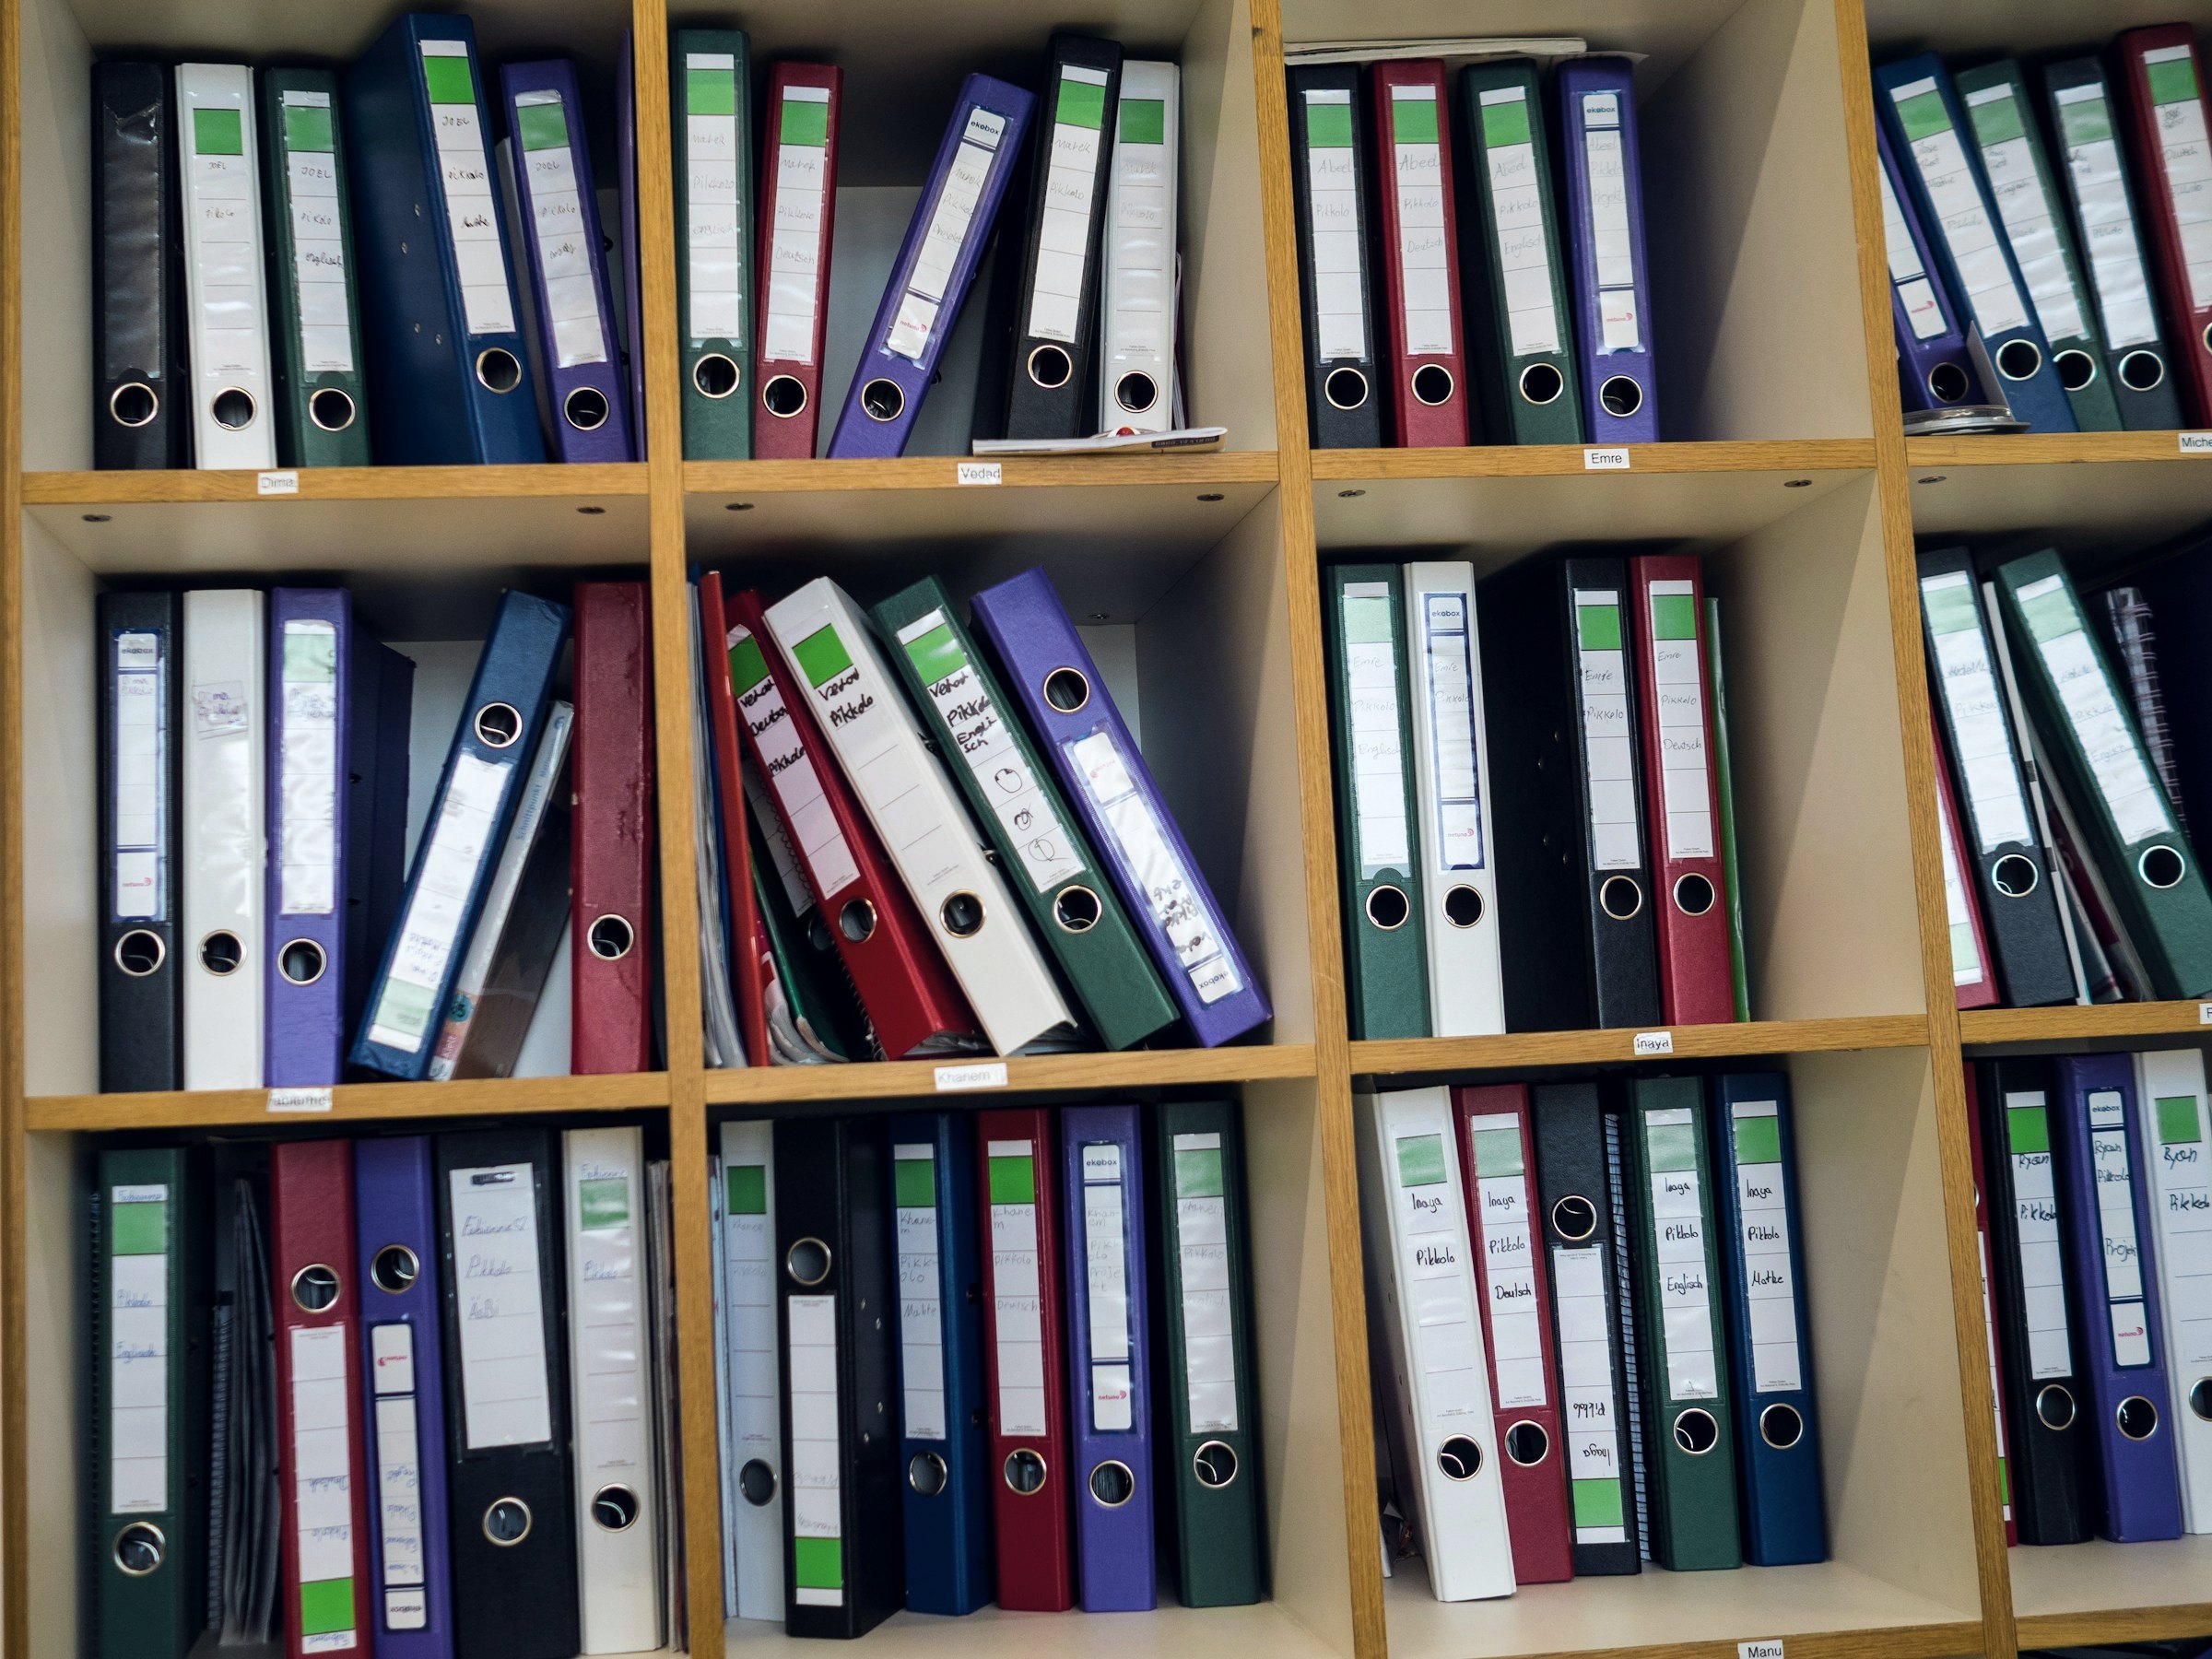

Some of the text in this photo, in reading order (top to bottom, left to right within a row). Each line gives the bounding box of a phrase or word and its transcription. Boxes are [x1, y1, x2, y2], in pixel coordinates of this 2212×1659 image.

[1586, 105, 1617, 114] ekobox
[970, 120, 1000, 136] ekobox
[1053, 137, 1092, 155] Marek
[1316, 203, 1350, 218] Pikkolo
[1592, 453, 1623, 465] Emre
[960, 467, 1001, 479] Vedad
[1431, 609, 1461, 618] ekobox
[1657, 650, 1682, 662] Emre
[1660, 694, 1697, 706] Pikkolo
[830, 693, 875, 727] Pikkolo
[1663, 737, 1702, 750] Deutsch
[1086, 1159, 1118, 1167] ekobox
[1746, 1179, 1773, 1199] Inaya
[1411, 1193, 1443, 1214] Inaya
[1488, 1191, 1516, 1210] Inaya
[1665, 1224, 1699, 1241] Pikkolo
[1747, 1225, 1781, 1241] Pikkolo
[1488, 1235, 1525, 1254] Pikkolo
[1416, 1246, 1456, 1266] Pikkolo
[1494, 1282, 1532, 1300] Deutsch
[1666, 1273, 1703, 1295] Englisch
[1572, 1402, 1606, 1418] Pikkolo
[1747, 1645, 1783, 1659] Manu
